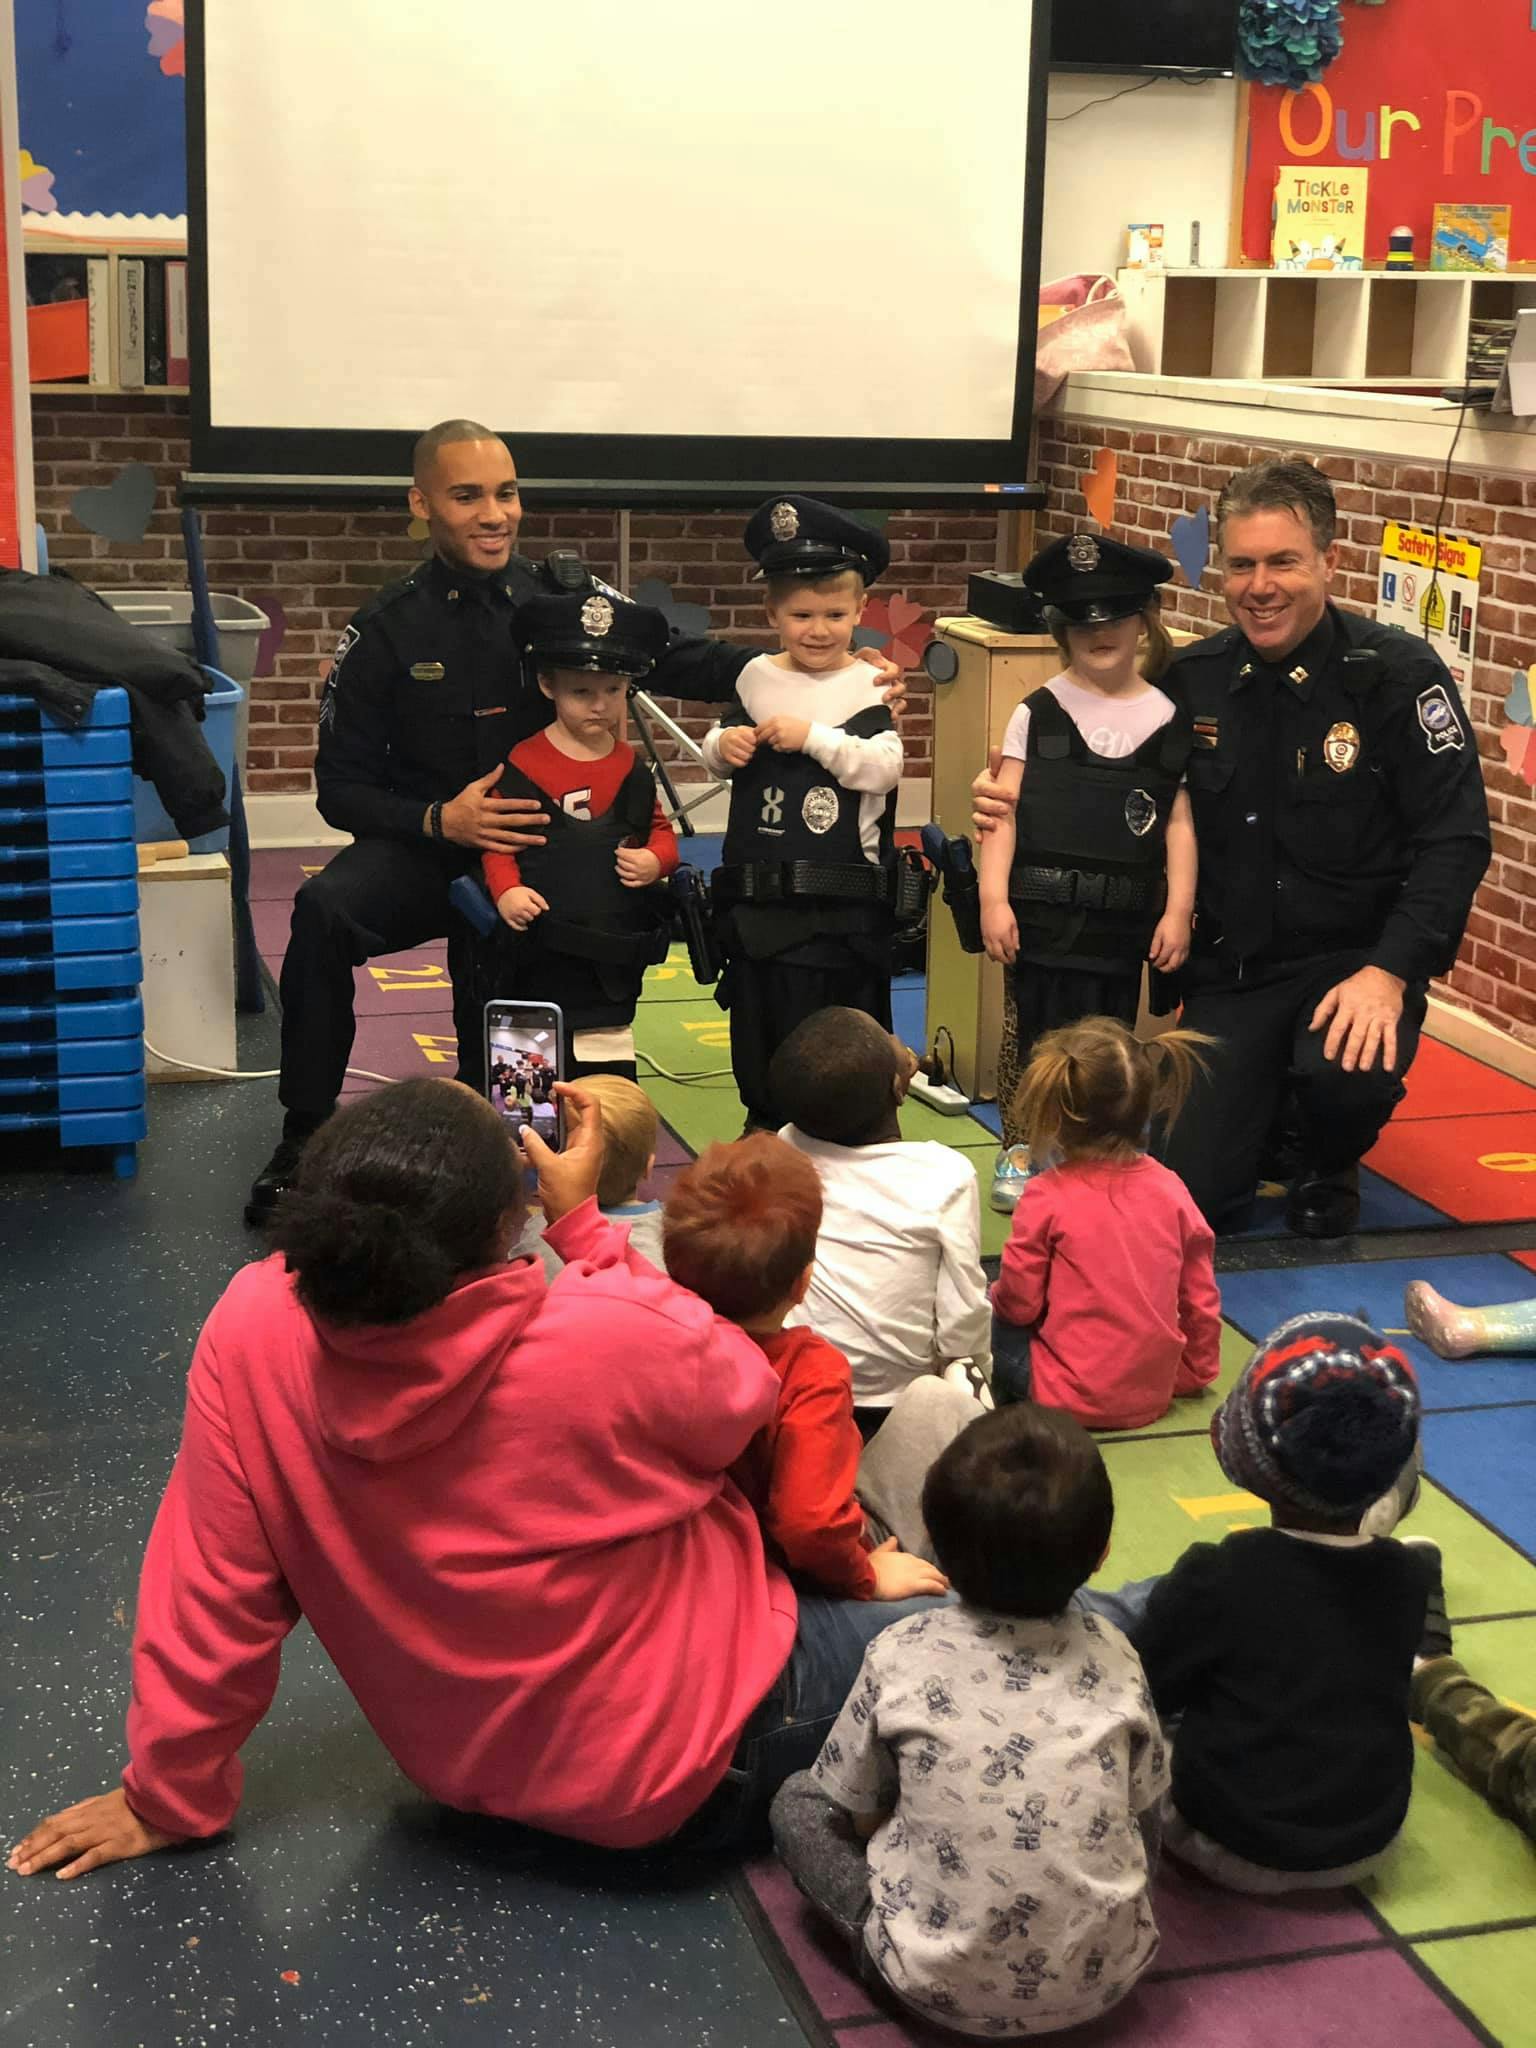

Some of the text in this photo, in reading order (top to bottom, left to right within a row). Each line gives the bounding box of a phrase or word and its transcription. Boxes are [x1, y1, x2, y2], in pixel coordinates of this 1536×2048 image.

[1279, 82, 1421, 161] Our
[1398, 532, 1466, 568] Safety Signs
[552, 787, 592, 821] 5
